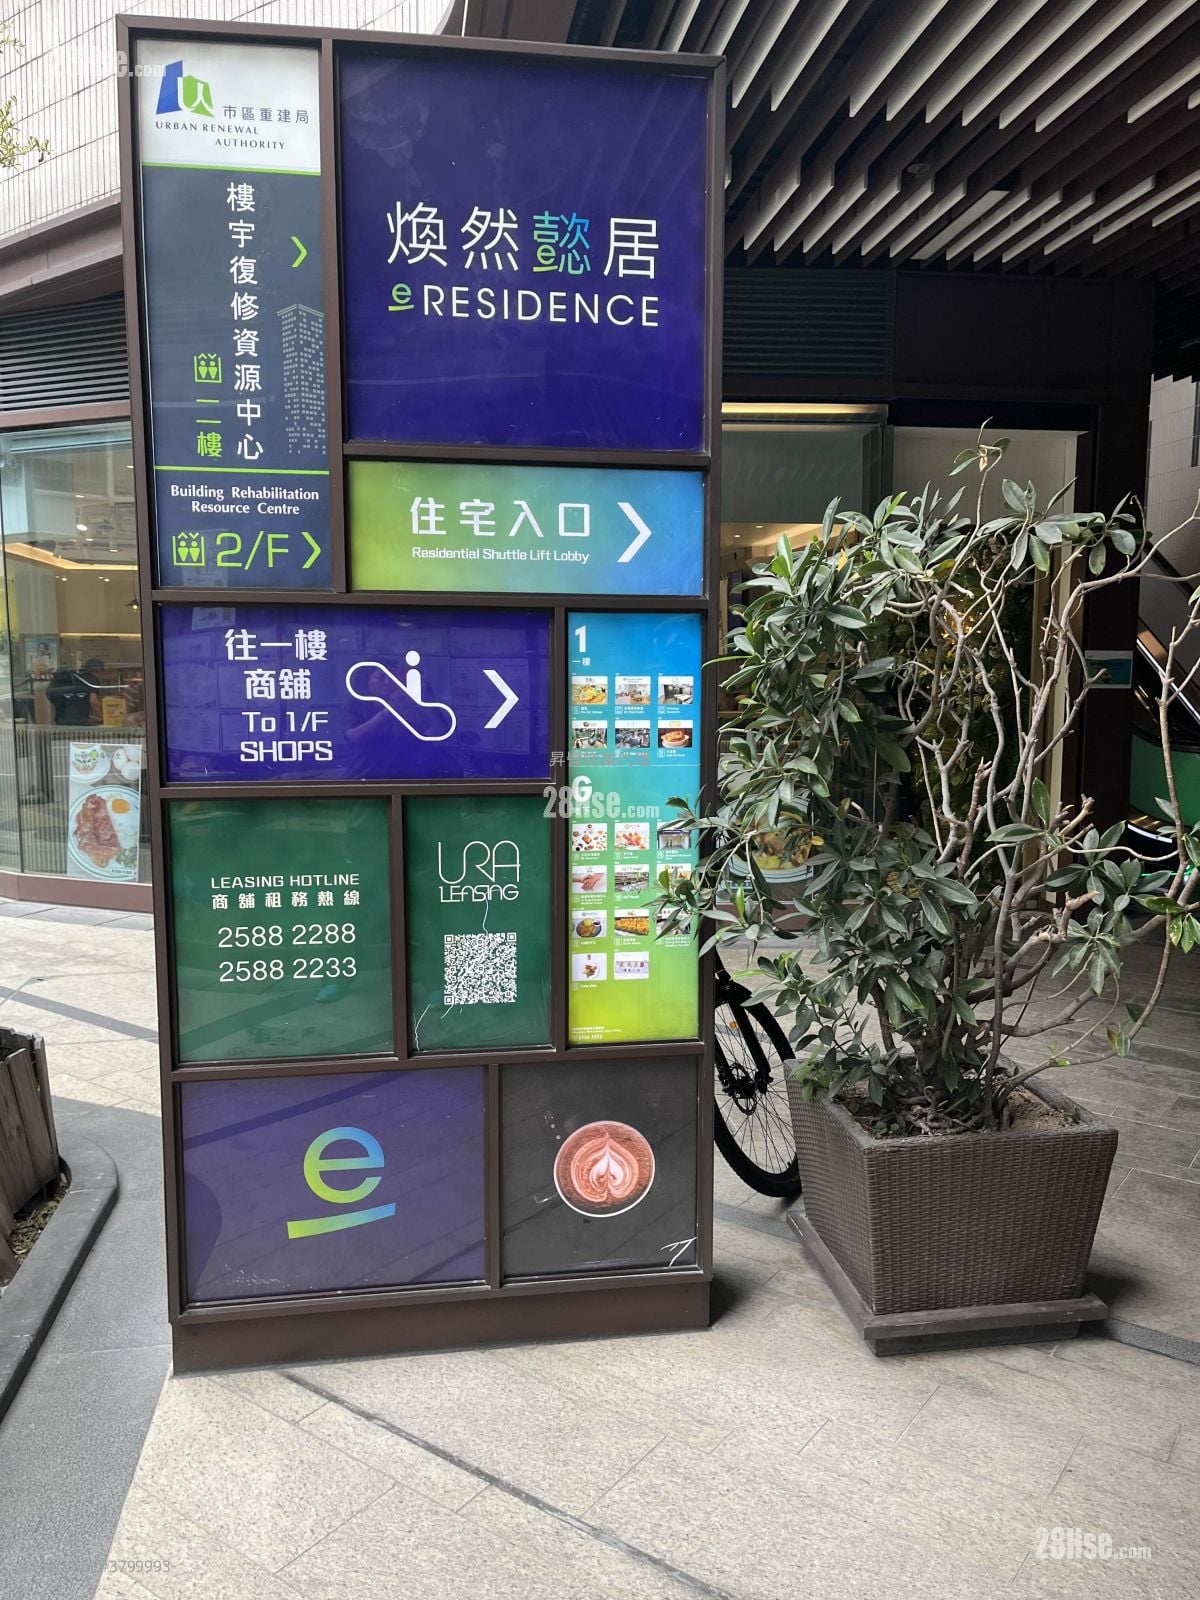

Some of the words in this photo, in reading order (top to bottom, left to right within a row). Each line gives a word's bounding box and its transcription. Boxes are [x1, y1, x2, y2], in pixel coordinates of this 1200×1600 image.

[223, 105, 309, 124] 市區重建局
[155, 121, 198, 131] URBAN
[202, 124, 260, 135] RENEWAL
[215, 138, 286, 150] AUTHORITY
[386, 201, 659, 279] 煥然懿居
[226, 182, 264, 461] 樓宇復修資源中心
[196, 398, 223, 458] 二樓
[170, 484, 224, 501] Building
[231, 486, 319, 501] Rehabilitation
[191, 501, 250, 514] Resource
[257, 502, 300, 515] Centre
[410, 496, 591, 538] 住宅入口
[215, 530, 289, 570] 2/F
[412, 547, 480, 560] Residential
[483, 548, 527, 561] Shuttle
[529, 549, 551, 561] Lift
[553, 550, 590, 564] Lobby
[224, 628, 328, 660] 往一樓
[574, 625, 587, 653] 1
[243, 668, 312, 700] 商舖
[241, 711, 277, 732] To
[286, 711, 329, 732] 1/F
[240, 740, 334, 762] SHOPS
[571, 775, 593, 803] G
[438, 840, 521, 884] URA
[211, 875, 285, 889] LEASING
[289, 873, 360, 887] HOTLINE
[438, 883, 520, 903] LEASING
[211, 890, 361, 910] 商舖租務熱線
[217, 925, 284, 948] 2588
[291, 923, 357, 945] 2288
[218, 959, 285, 982] 2588
[292, 957, 357, 979] 2233
